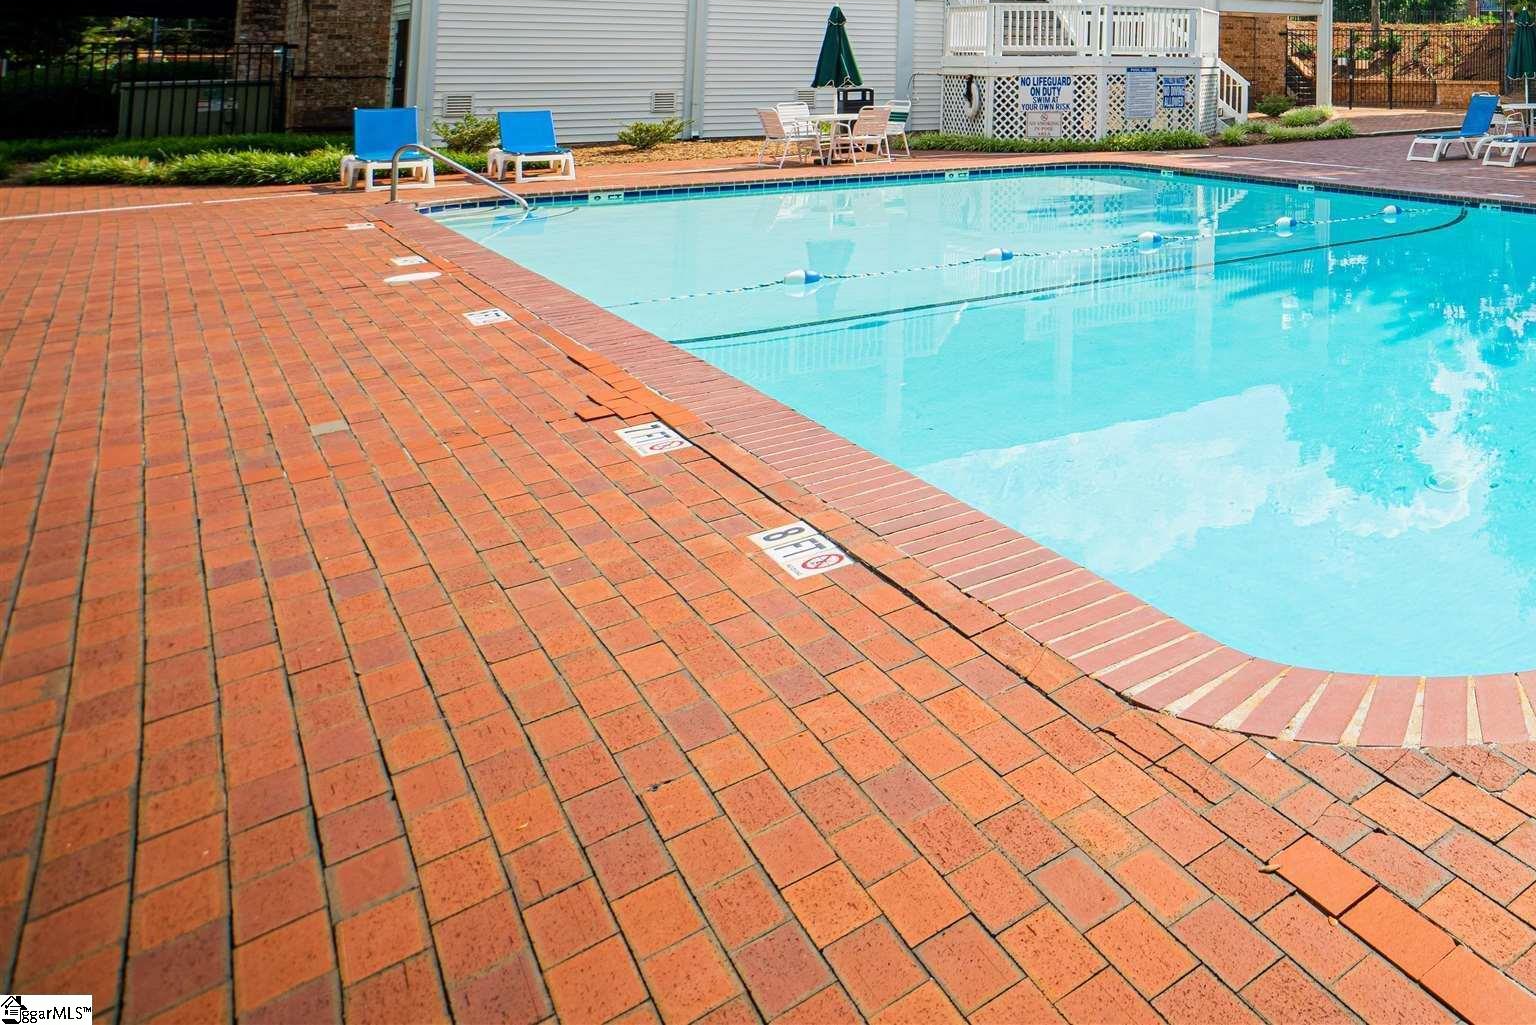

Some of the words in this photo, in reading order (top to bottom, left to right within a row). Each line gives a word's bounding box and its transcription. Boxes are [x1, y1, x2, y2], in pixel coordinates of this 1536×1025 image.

[1020, 76, 1031, 86] NO
[1032, 76, 1072, 86] LIFEGUARD
[1030, 87, 1041, 96] ON
[1042, 87, 1061, 96] DUTY
[762, 526, 806, 542] 8
[773, 537, 827, 558] FT
